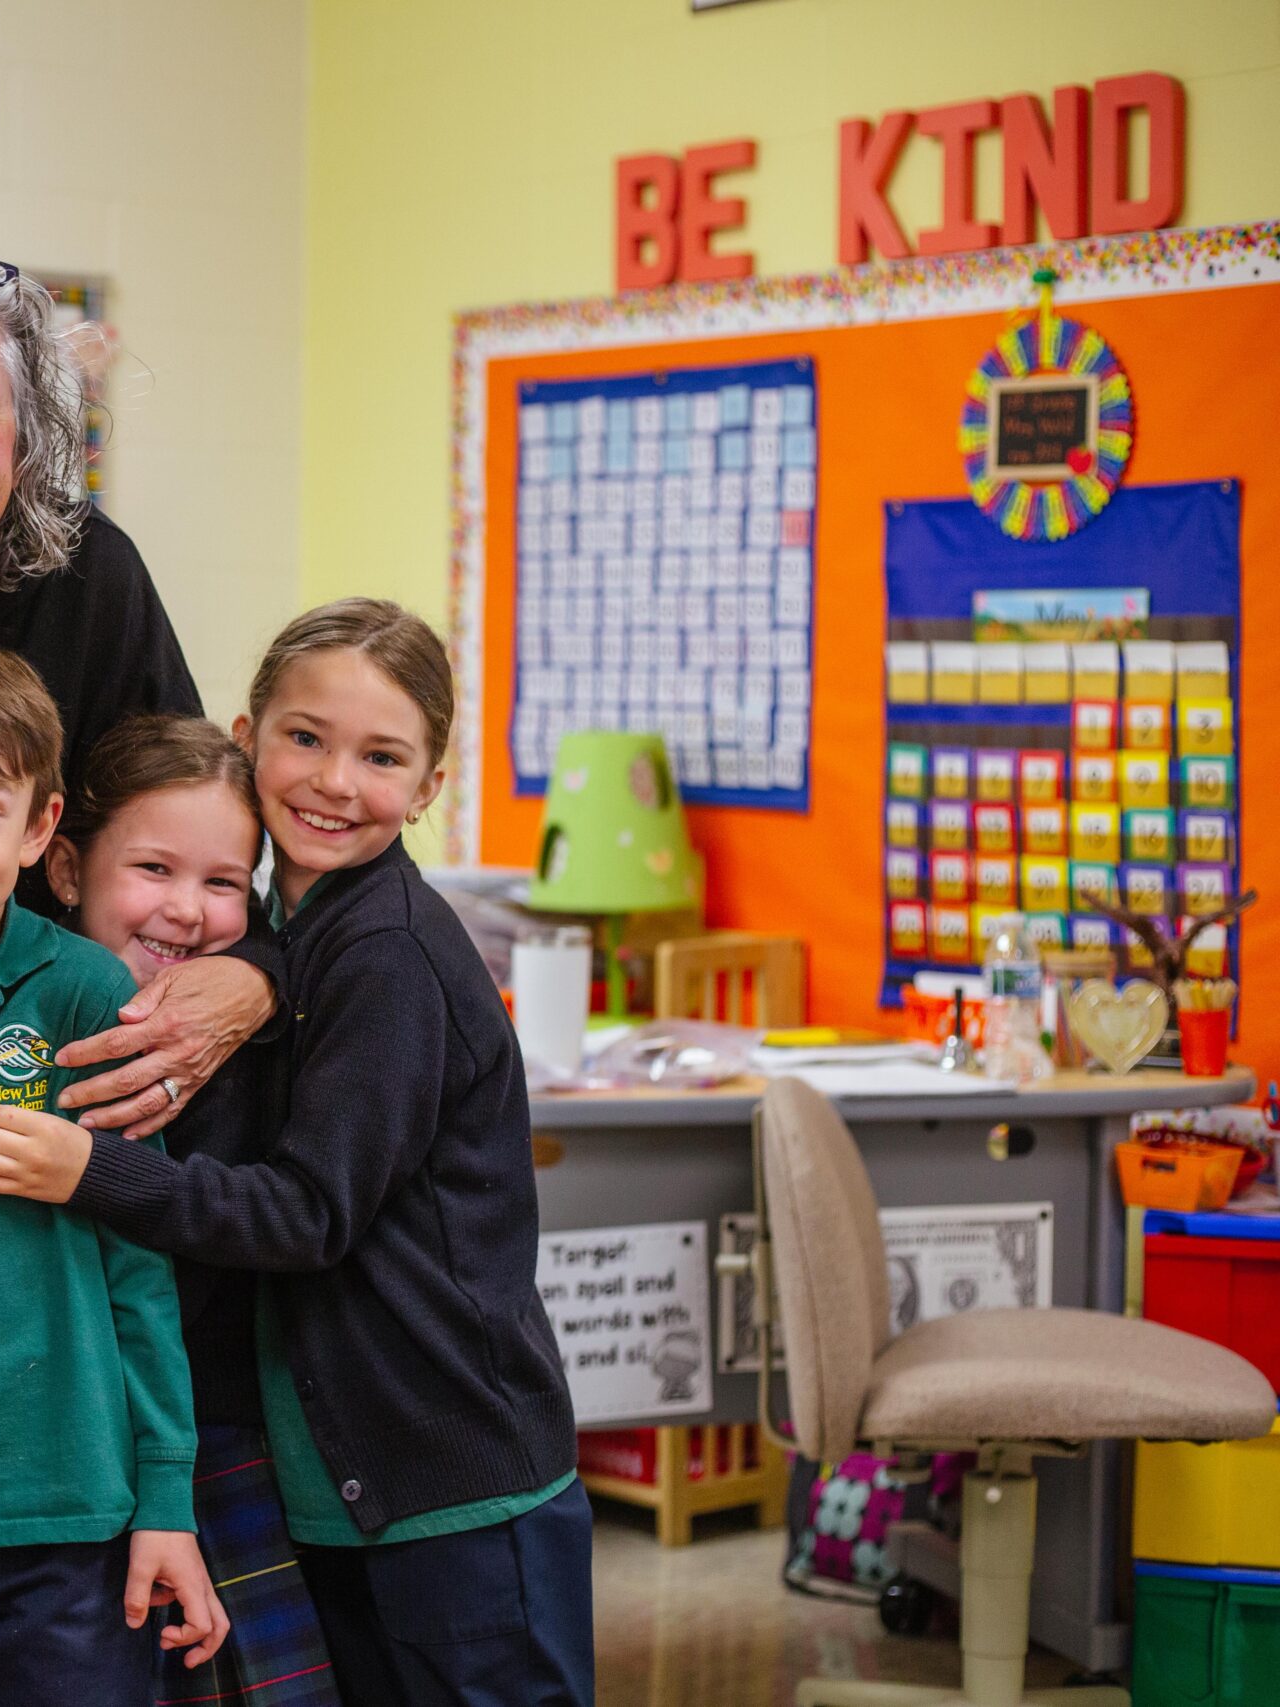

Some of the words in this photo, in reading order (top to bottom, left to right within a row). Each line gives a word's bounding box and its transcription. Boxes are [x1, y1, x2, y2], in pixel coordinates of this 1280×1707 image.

[614, 139, 758, 292] BE
[838, 70, 1186, 267] KIND
[1194, 714, 1216, 744] 3
[1193, 766, 1221, 799] 10
[1191, 821, 1219, 854] 17
[634, 1268, 676, 1293] and
[562, 1311, 632, 1334] words
[640, 1304, 692, 1328] with
[577, 1342, 618, 1369] and
